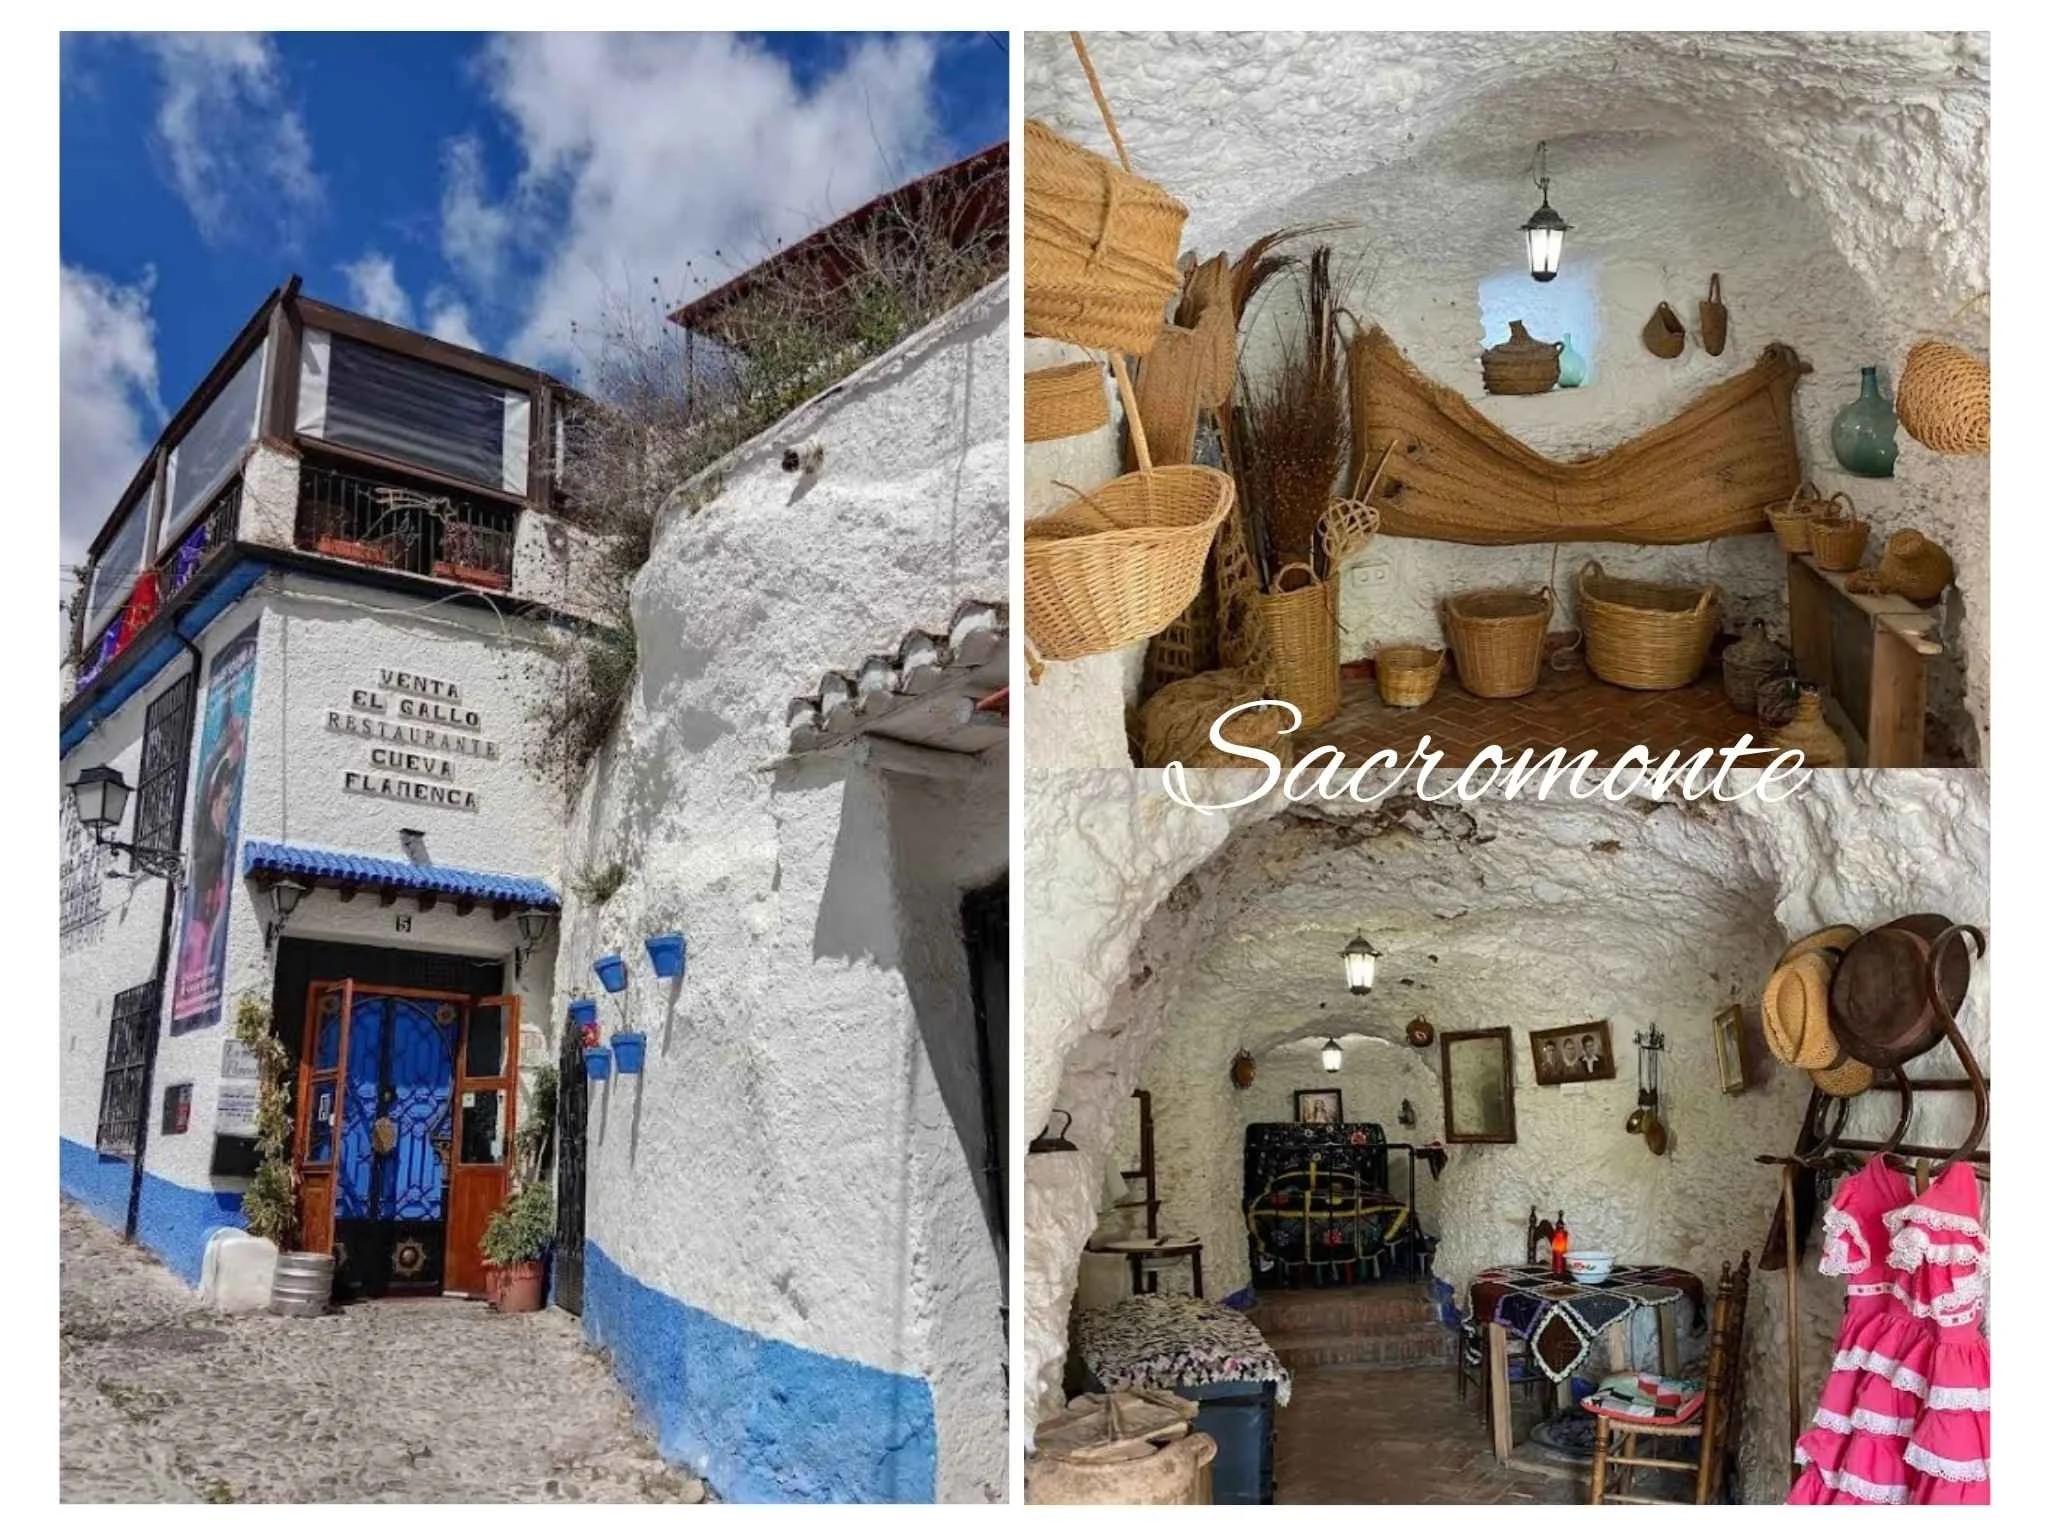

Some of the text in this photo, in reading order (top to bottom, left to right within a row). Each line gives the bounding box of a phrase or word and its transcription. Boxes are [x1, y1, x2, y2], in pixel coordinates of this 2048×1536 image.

[379, 668, 460, 699] VENTA
[352, 689, 480, 727] EL GALLO
[328, 711, 499, 758] RESTAURANTE
[371, 748, 452, 778] CUEVA
[344, 771, 478, 808] FLAMENCA
[396, 914, 412, 933] 5
